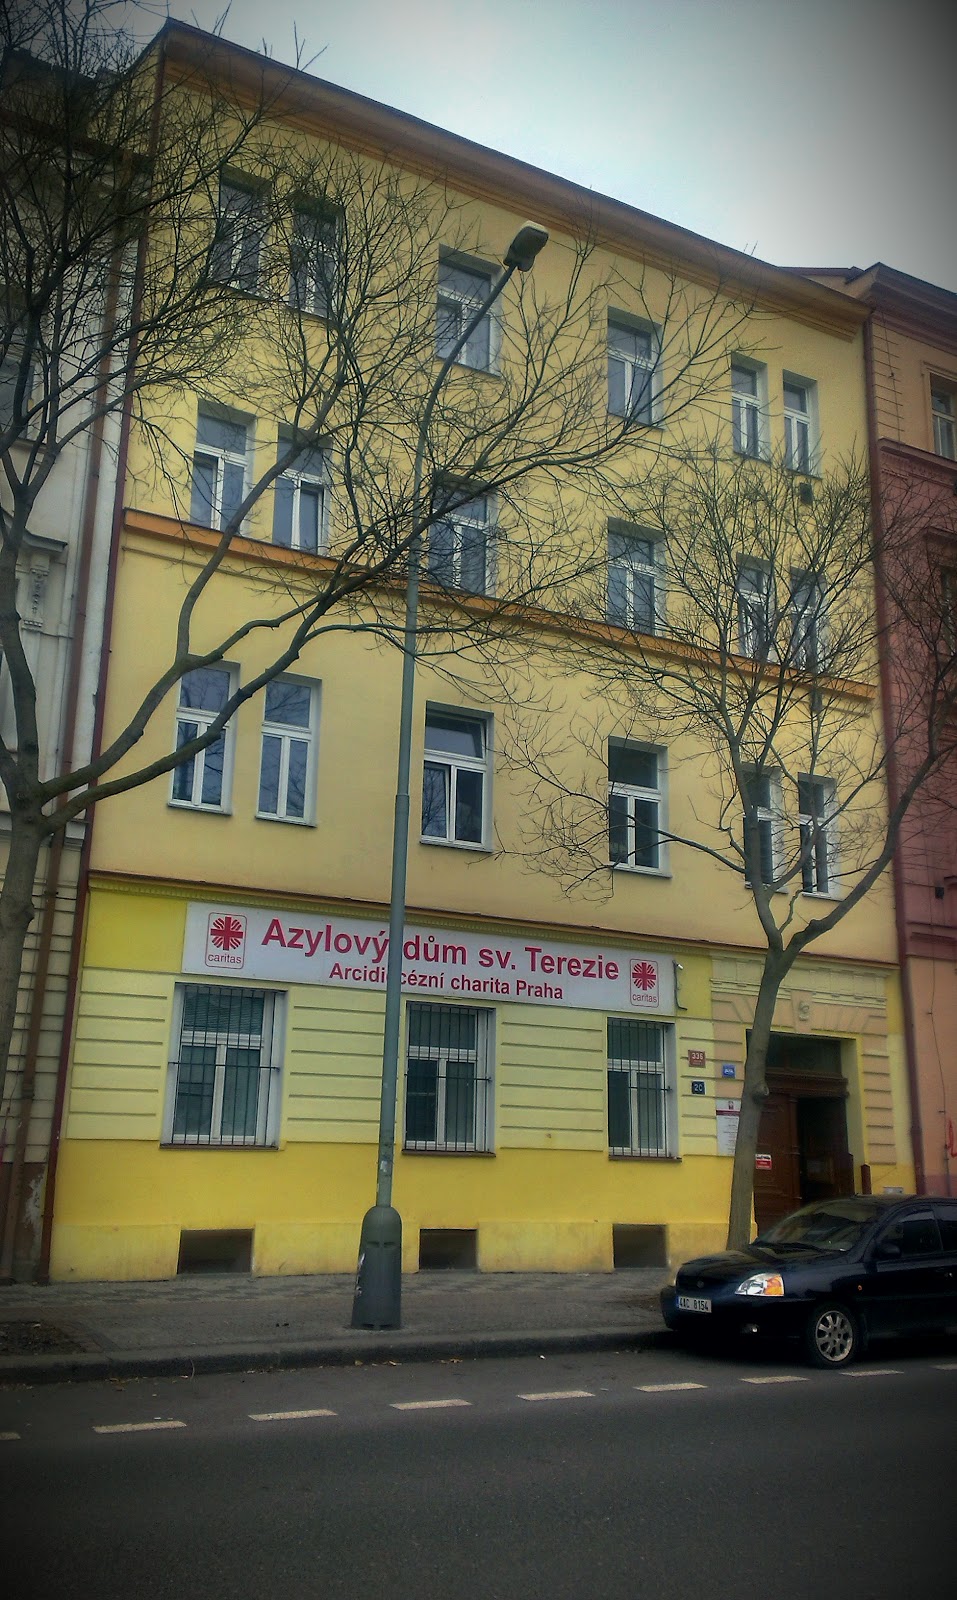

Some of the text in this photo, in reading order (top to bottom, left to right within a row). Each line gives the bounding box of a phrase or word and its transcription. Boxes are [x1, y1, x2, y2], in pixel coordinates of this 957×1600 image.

[207, 953, 242, 964] caritas
[261, 918, 620, 980] Azylový dům sv. Terezie
[328, 962, 564, 999] Arcidicézní charita Praha
[632, 993, 658, 1003] caritas
